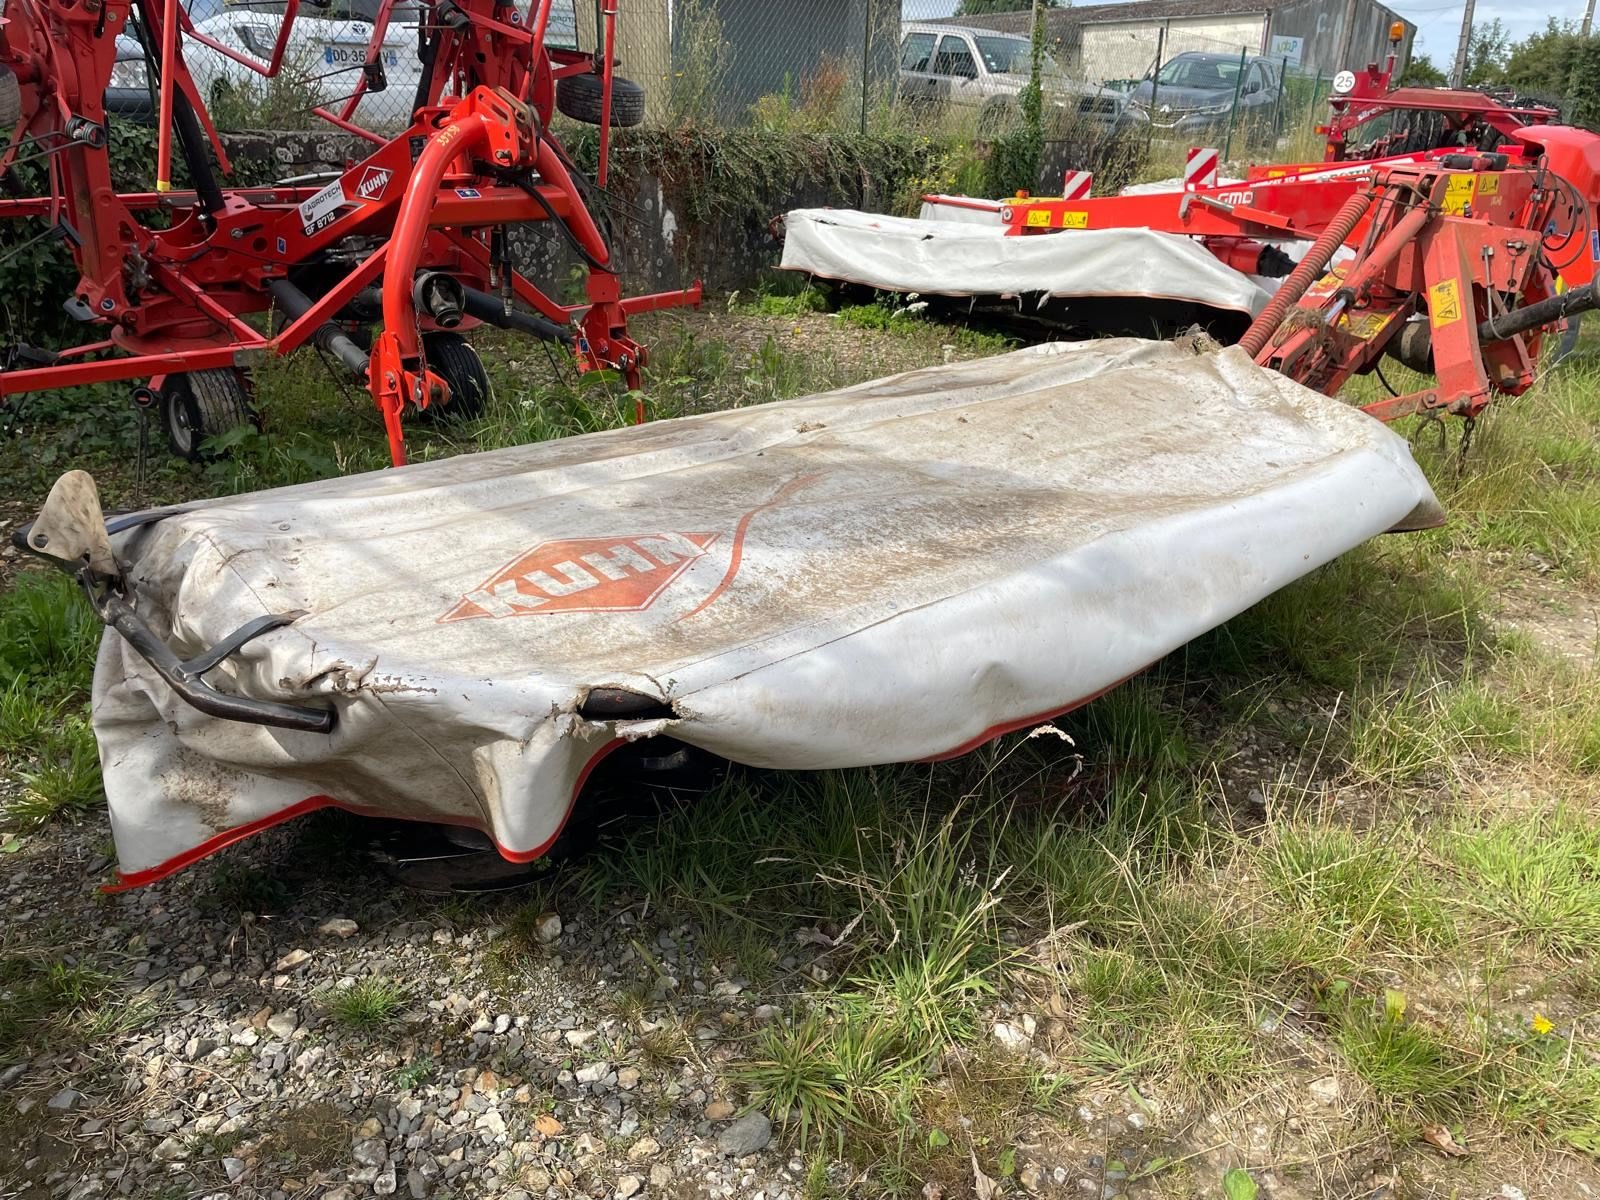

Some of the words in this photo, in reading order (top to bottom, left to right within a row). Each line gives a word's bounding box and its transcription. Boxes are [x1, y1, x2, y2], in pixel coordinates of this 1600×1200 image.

[1336, 76, 1353, 88] 25
[359, 171, 389, 197] KUHN
[307, 185, 341, 211] AGROTECH
[1217, 191, 1254, 205] GMD
[305, 224, 316, 236] GF
[317, 211, 336, 229] 8712
[463, 531, 709, 619] KUHN
